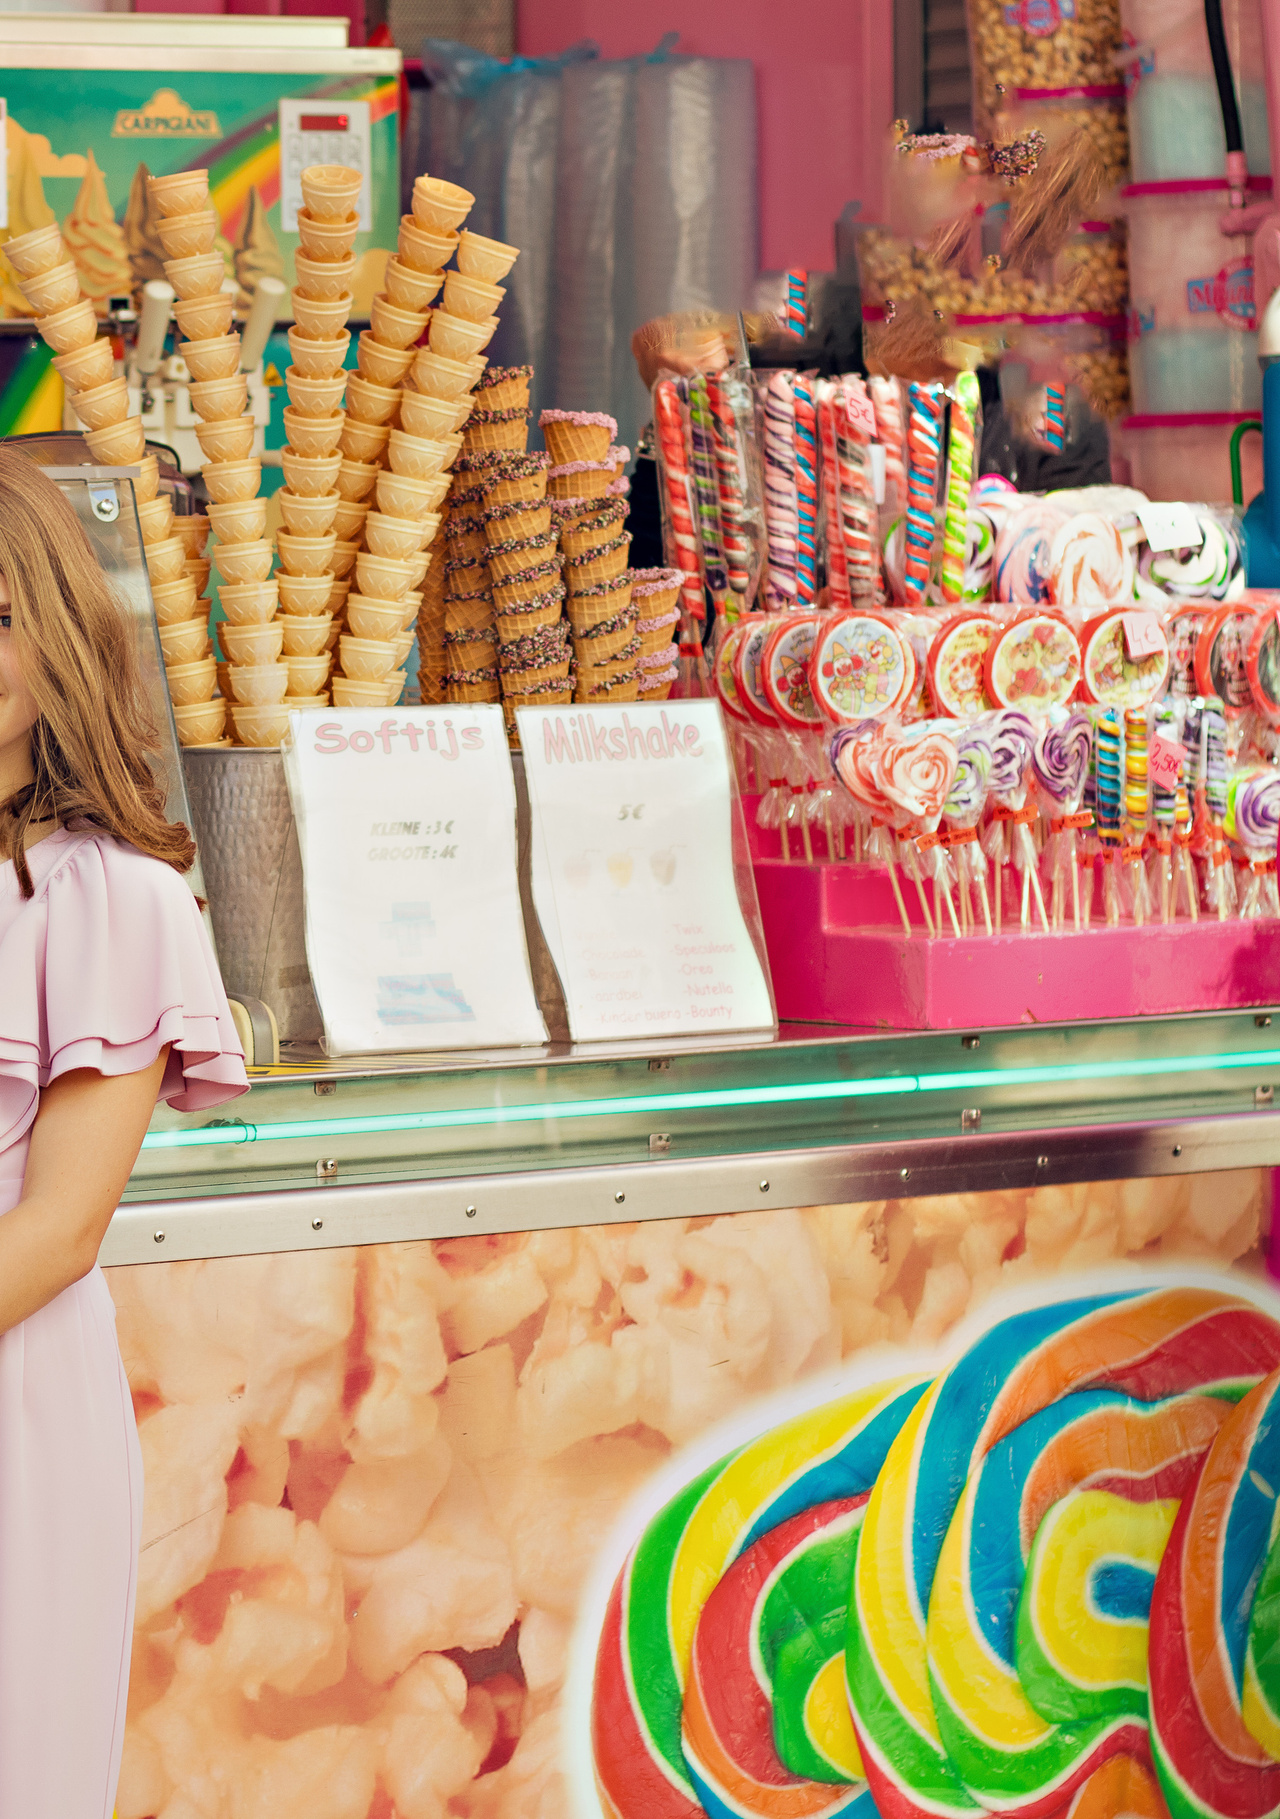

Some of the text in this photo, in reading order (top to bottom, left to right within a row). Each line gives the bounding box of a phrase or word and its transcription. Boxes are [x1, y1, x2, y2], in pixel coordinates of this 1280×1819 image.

[849, 397, 873, 425] 5€
[1130, 621, 1158, 655] 4€
[313, 718, 484, 761] Softijs
[541, 709, 705, 764] Milkshake
[1150, 742, 1182, 774] 2,50€
[370, 821, 422, 837] KLEINE
